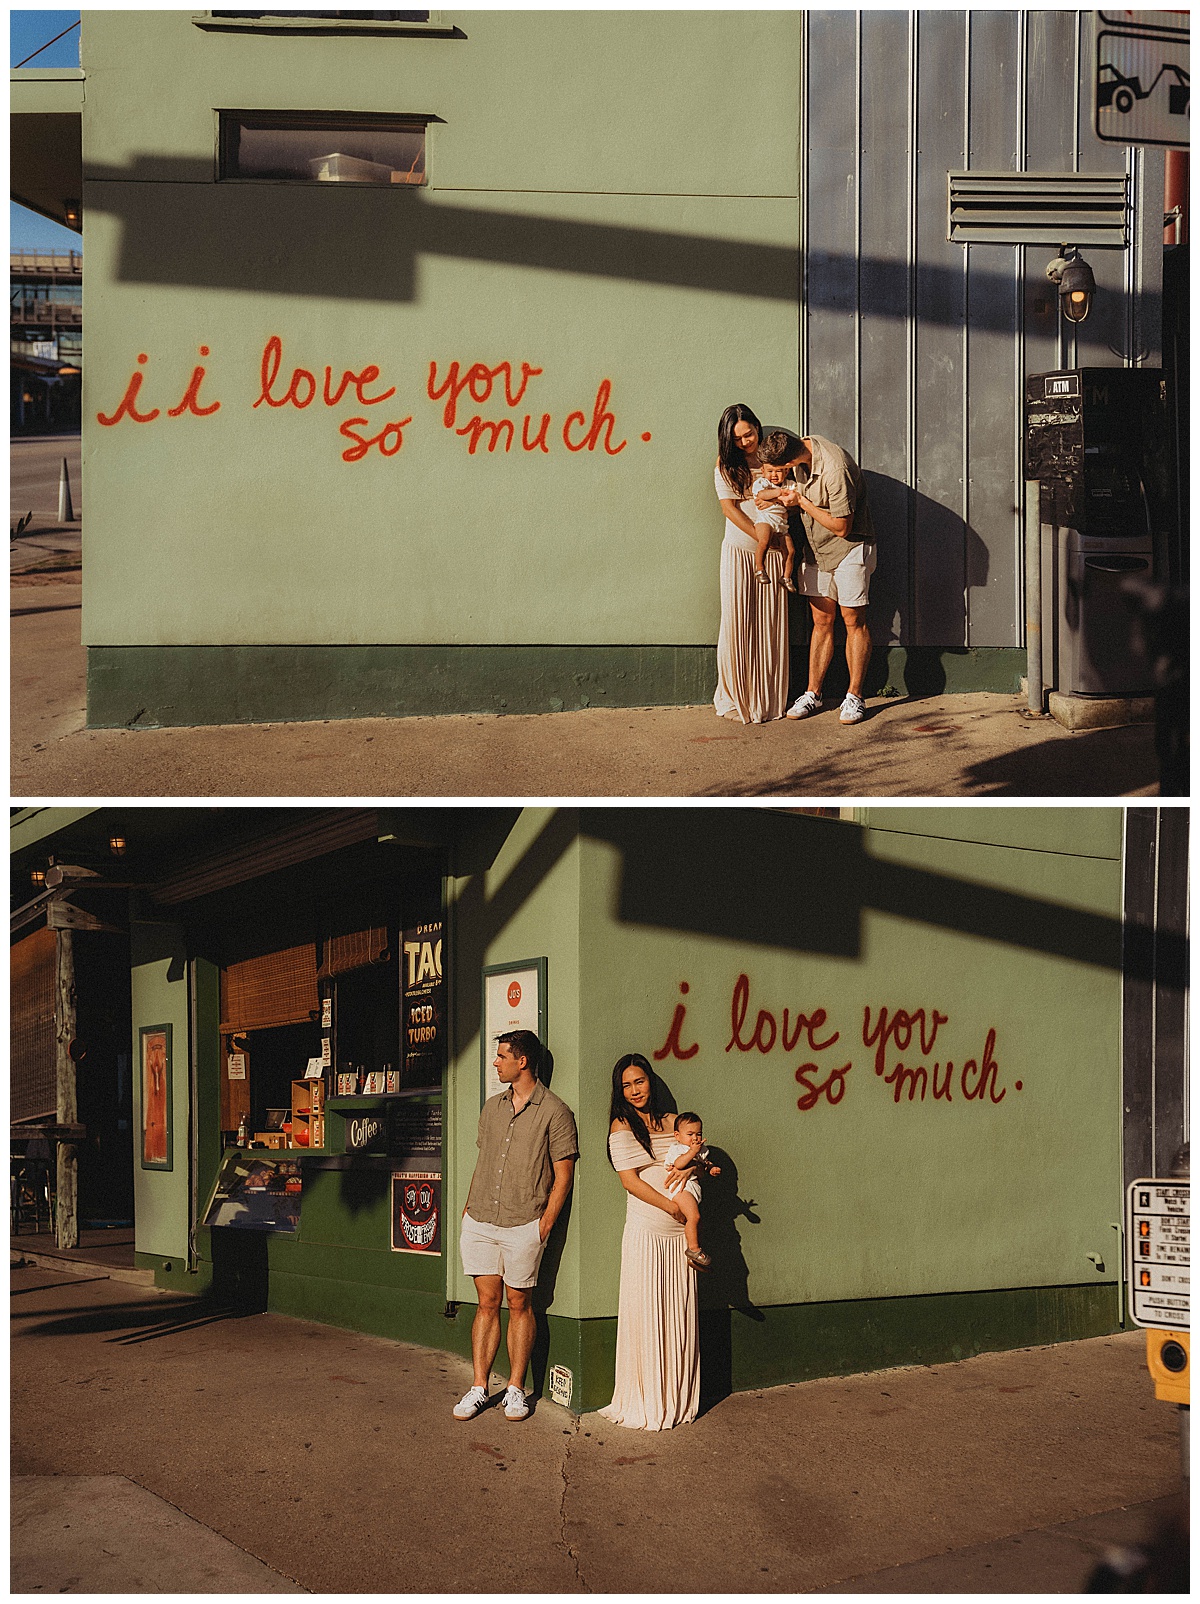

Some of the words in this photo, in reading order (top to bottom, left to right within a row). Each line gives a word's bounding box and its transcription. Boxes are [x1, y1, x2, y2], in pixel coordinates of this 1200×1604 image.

[97, 353, 160, 426] i
[167, 346, 221, 417] i
[253, 336, 396, 409] love
[1053, 380, 1069, 393] ATM
[339, 417, 412, 462] so
[456, 379, 651, 455] much.
[411, 1005, 432, 1024] ICED
[653, 982, 699, 1061] i
[725, 974, 840, 1054] love
[408, 1025, 436, 1045] TURBO
[794, 1062, 852, 1111] so
[884, 1028, 1022, 1104] much.
[351, 1117, 378, 1147] Coffee
[1149, 1296, 1164, 1304] PUSH
[1164, 1311, 1185, 1320] CROSS
